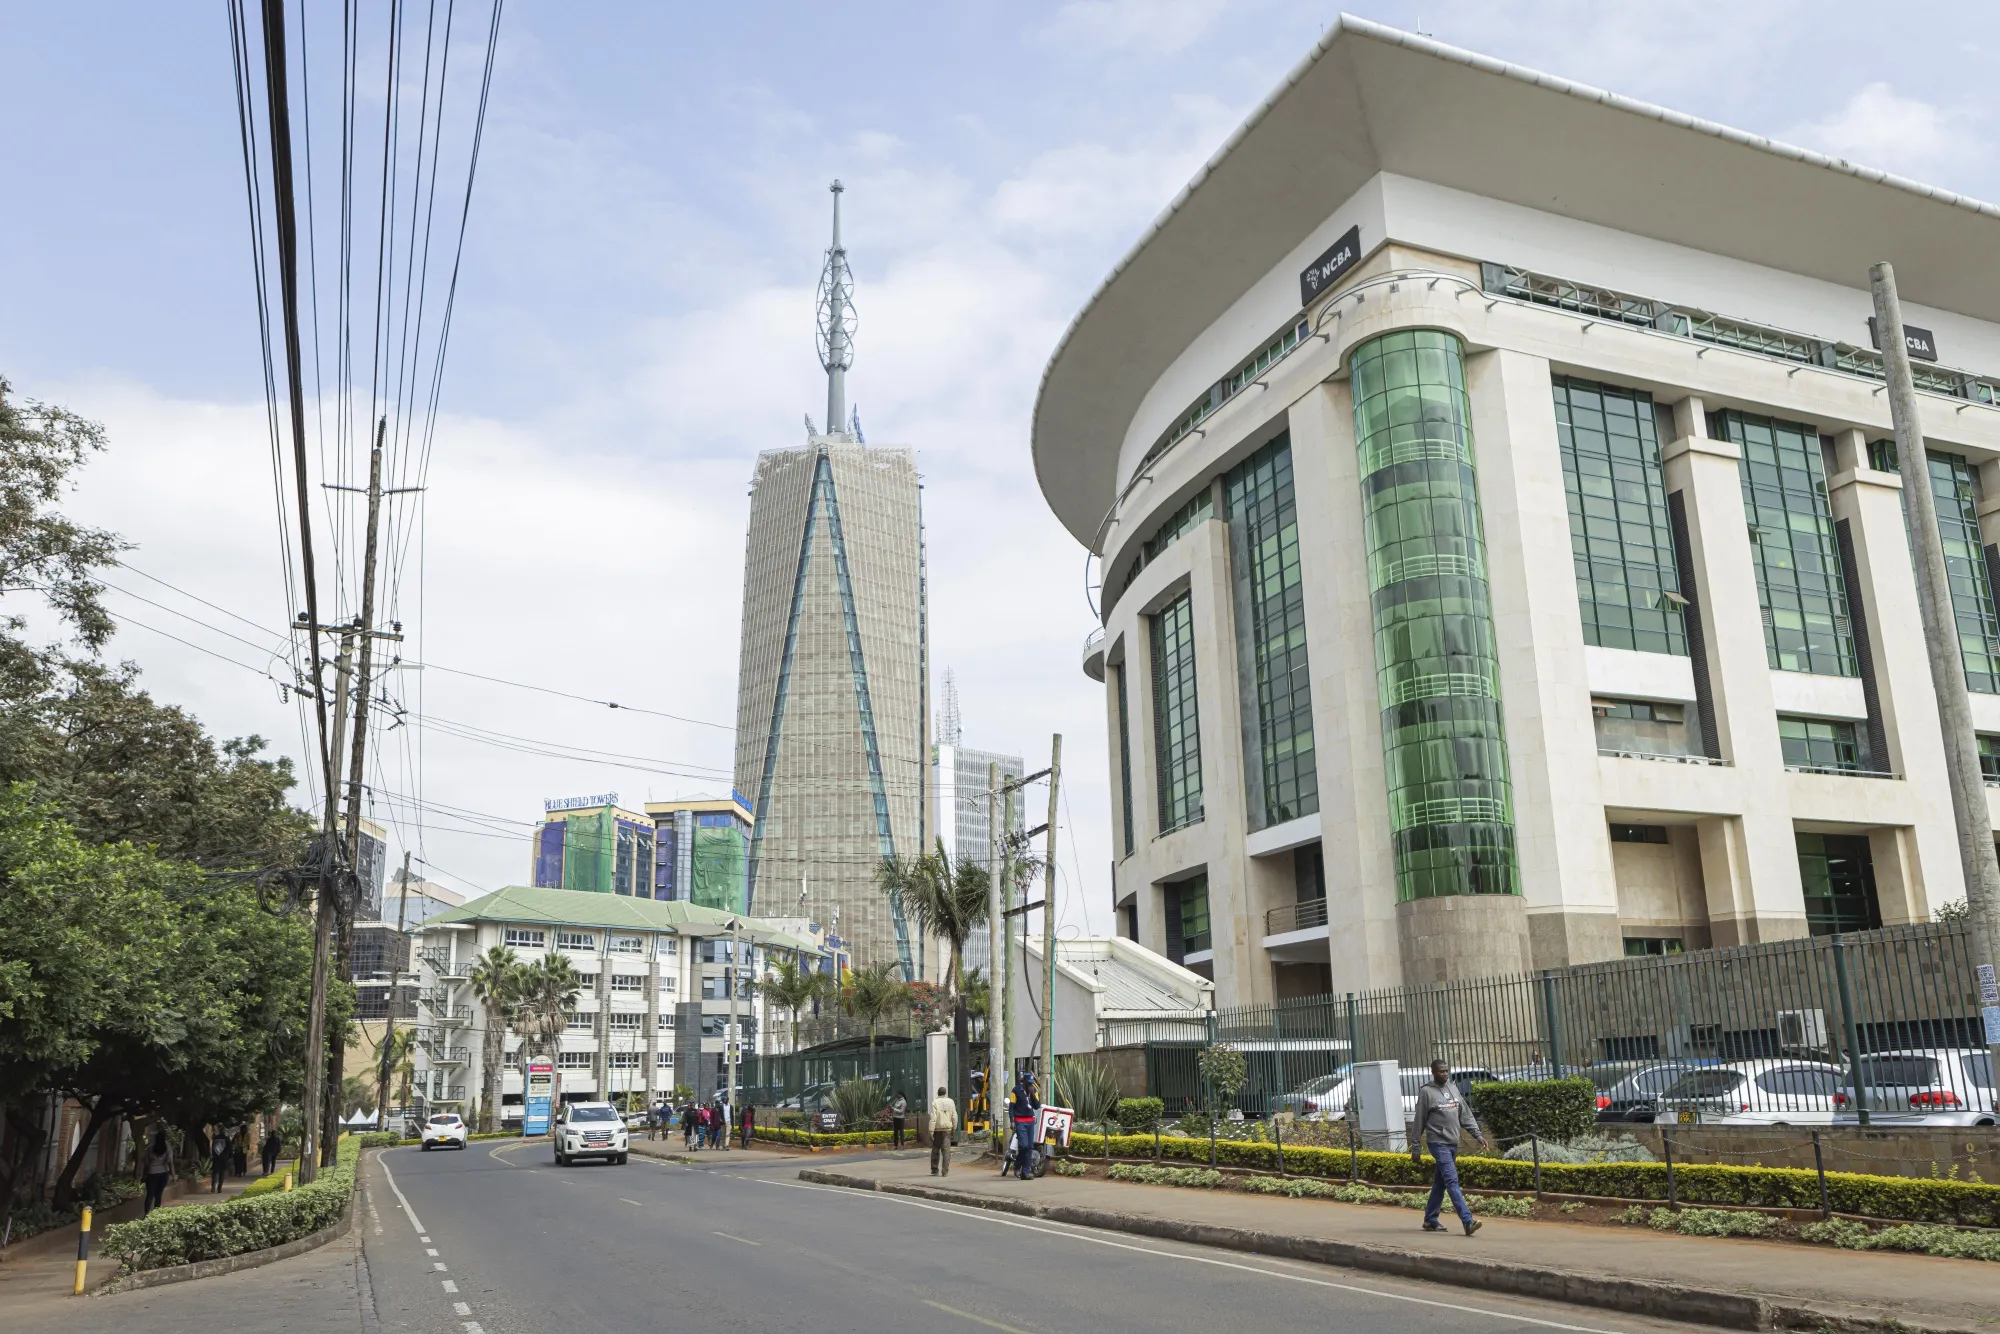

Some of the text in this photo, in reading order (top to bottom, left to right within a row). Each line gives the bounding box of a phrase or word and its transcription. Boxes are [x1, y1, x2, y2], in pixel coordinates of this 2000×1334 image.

[1322, 246, 1351, 279] NCBA
[1906, 336, 1929, 352] CBA
[544, 793, 619, 810] BLUE SHIELD TOWERS
